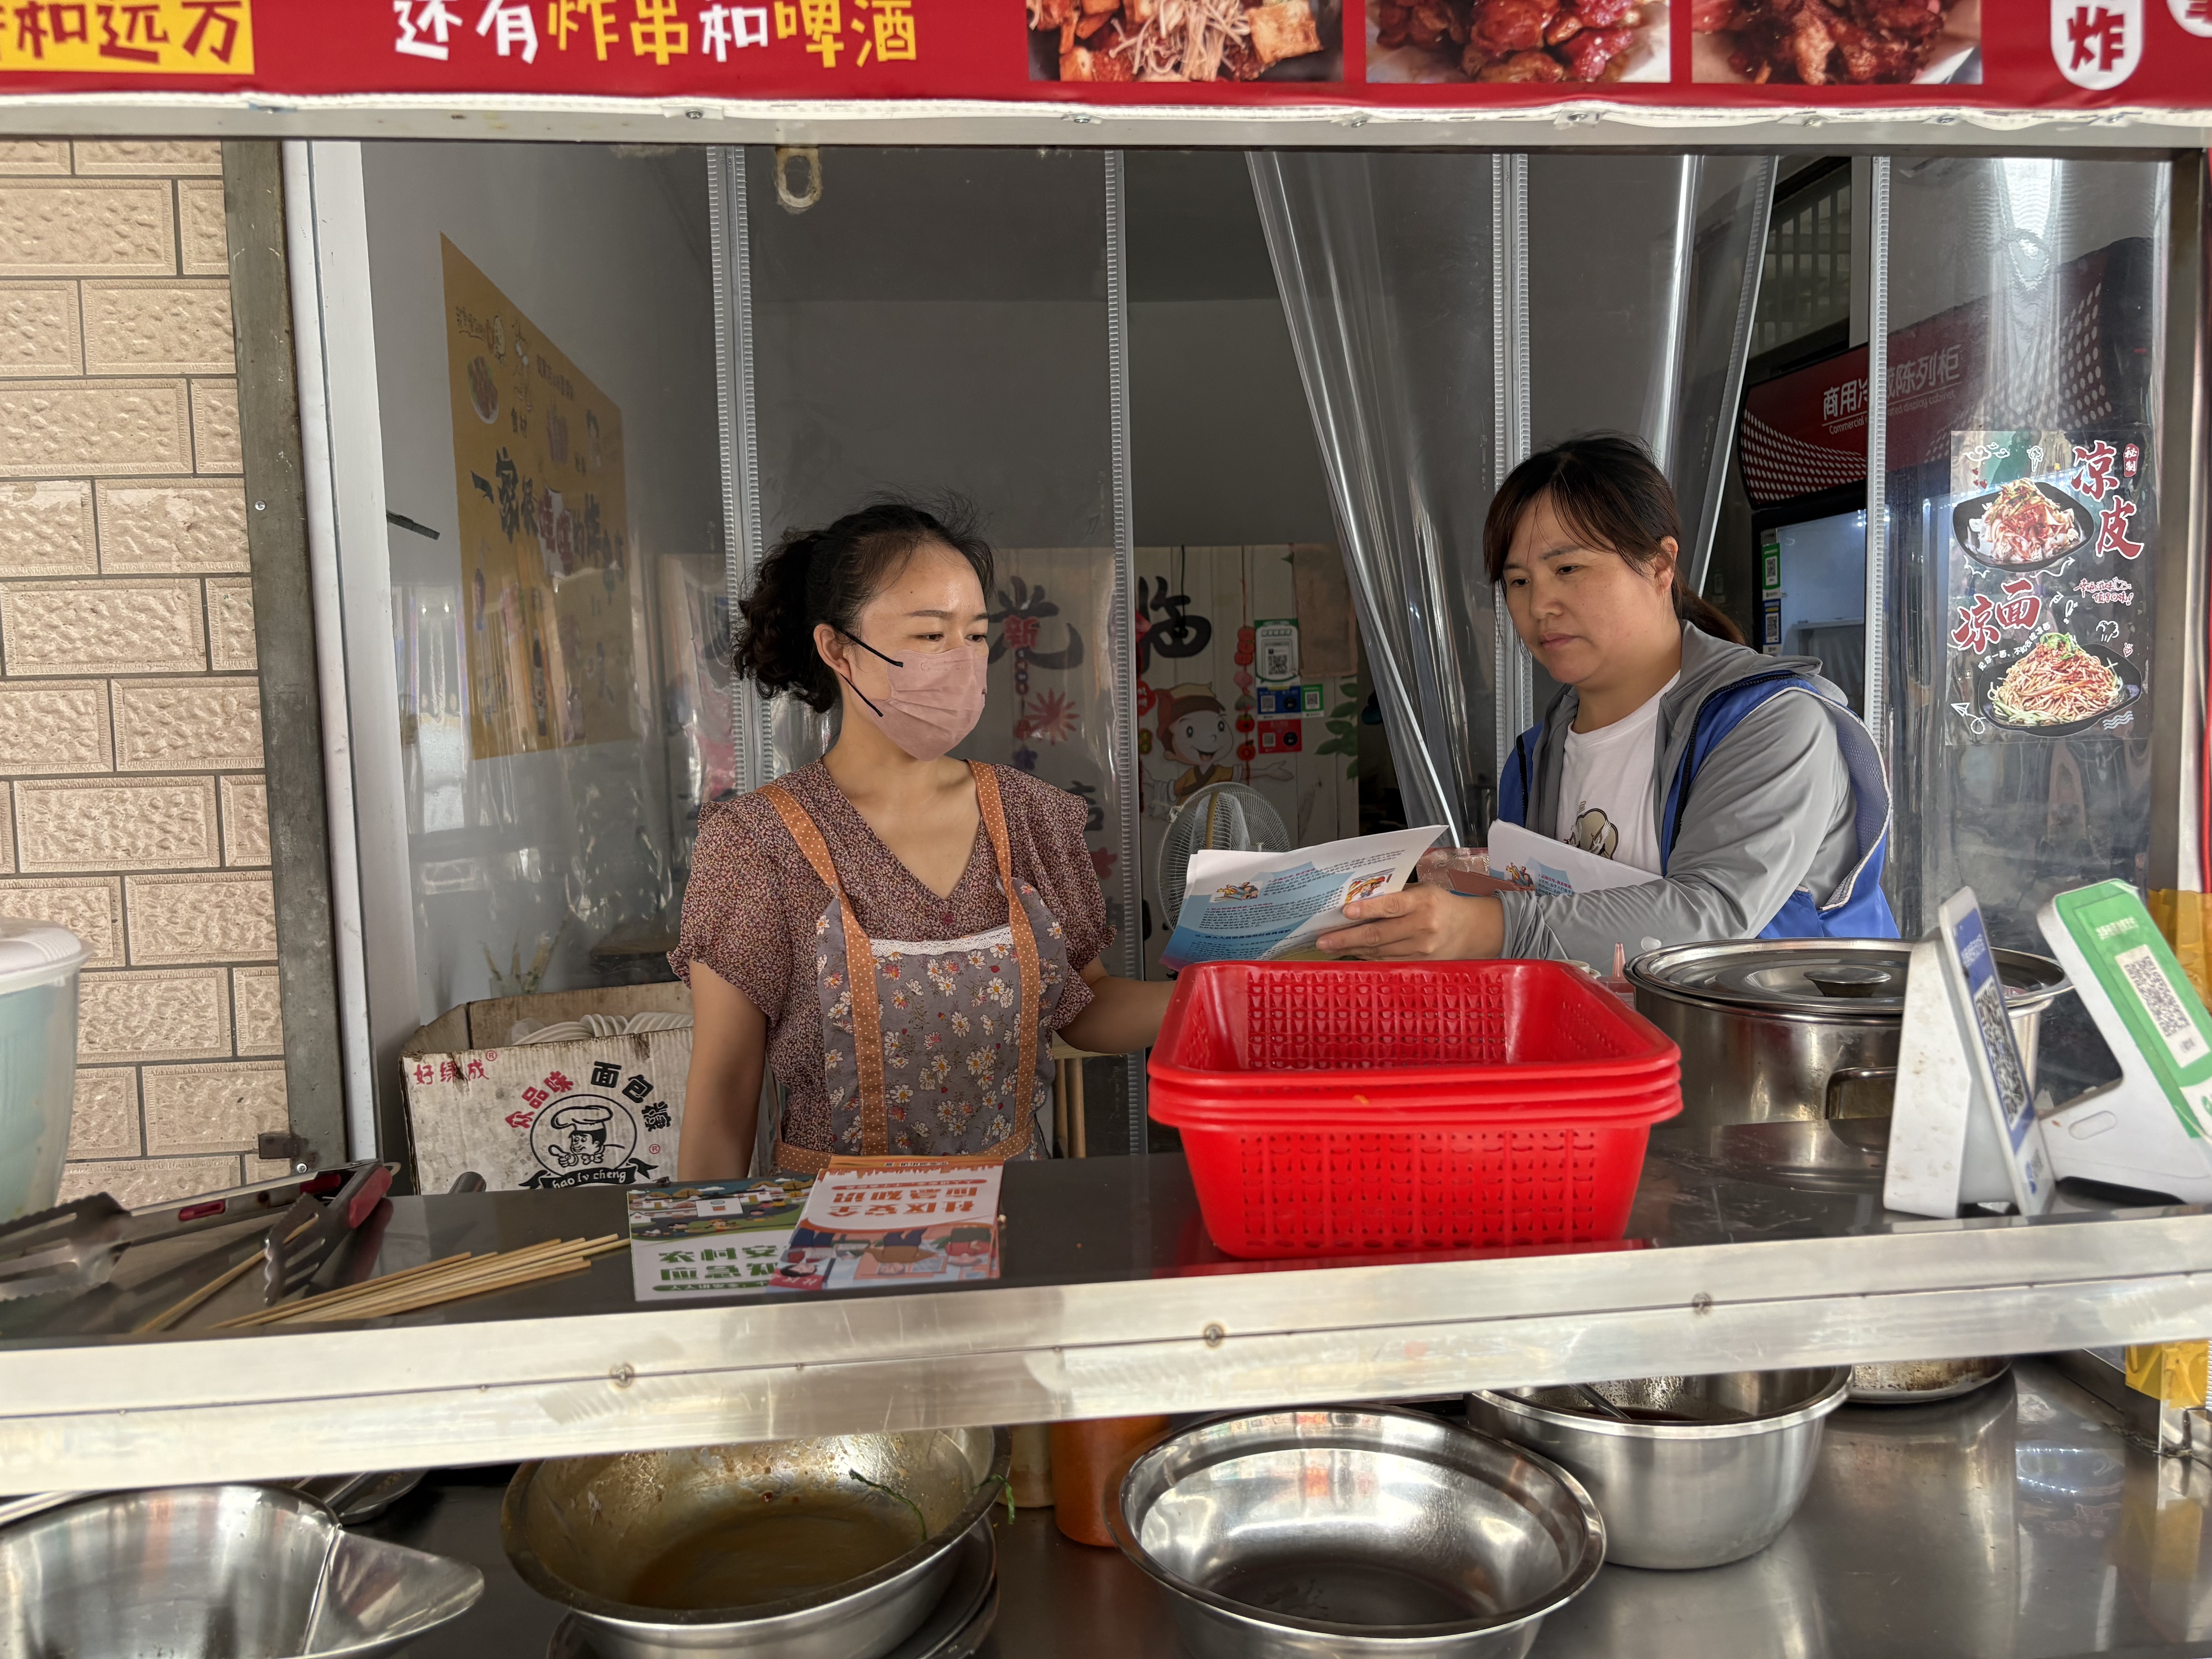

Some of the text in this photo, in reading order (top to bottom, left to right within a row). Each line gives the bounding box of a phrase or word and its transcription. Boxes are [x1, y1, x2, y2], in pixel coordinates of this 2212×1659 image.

[394, 0, 917, 68] 还有炸串和啤酒
[2067, 7, 2124, 72] 炸
[1829, 389, 1955, 434] Commercial display cabinet
[2124, 446, 2138, 473] 秘制
[2070, 440, 2144, 560] 凉皮
[1951, 577, 2042, 654] 凉面
[505, 1061, 672, 1133] 众品味 面包糠
[552, 1176, 575, 1189] hao
[593, 1169, 627, 1185] cheng
[833, 1187, 977, 1203] 应急知识
[827, 1200, 974, 1218] 社区安全
[658, 1244, 786, 1263] 农村安
